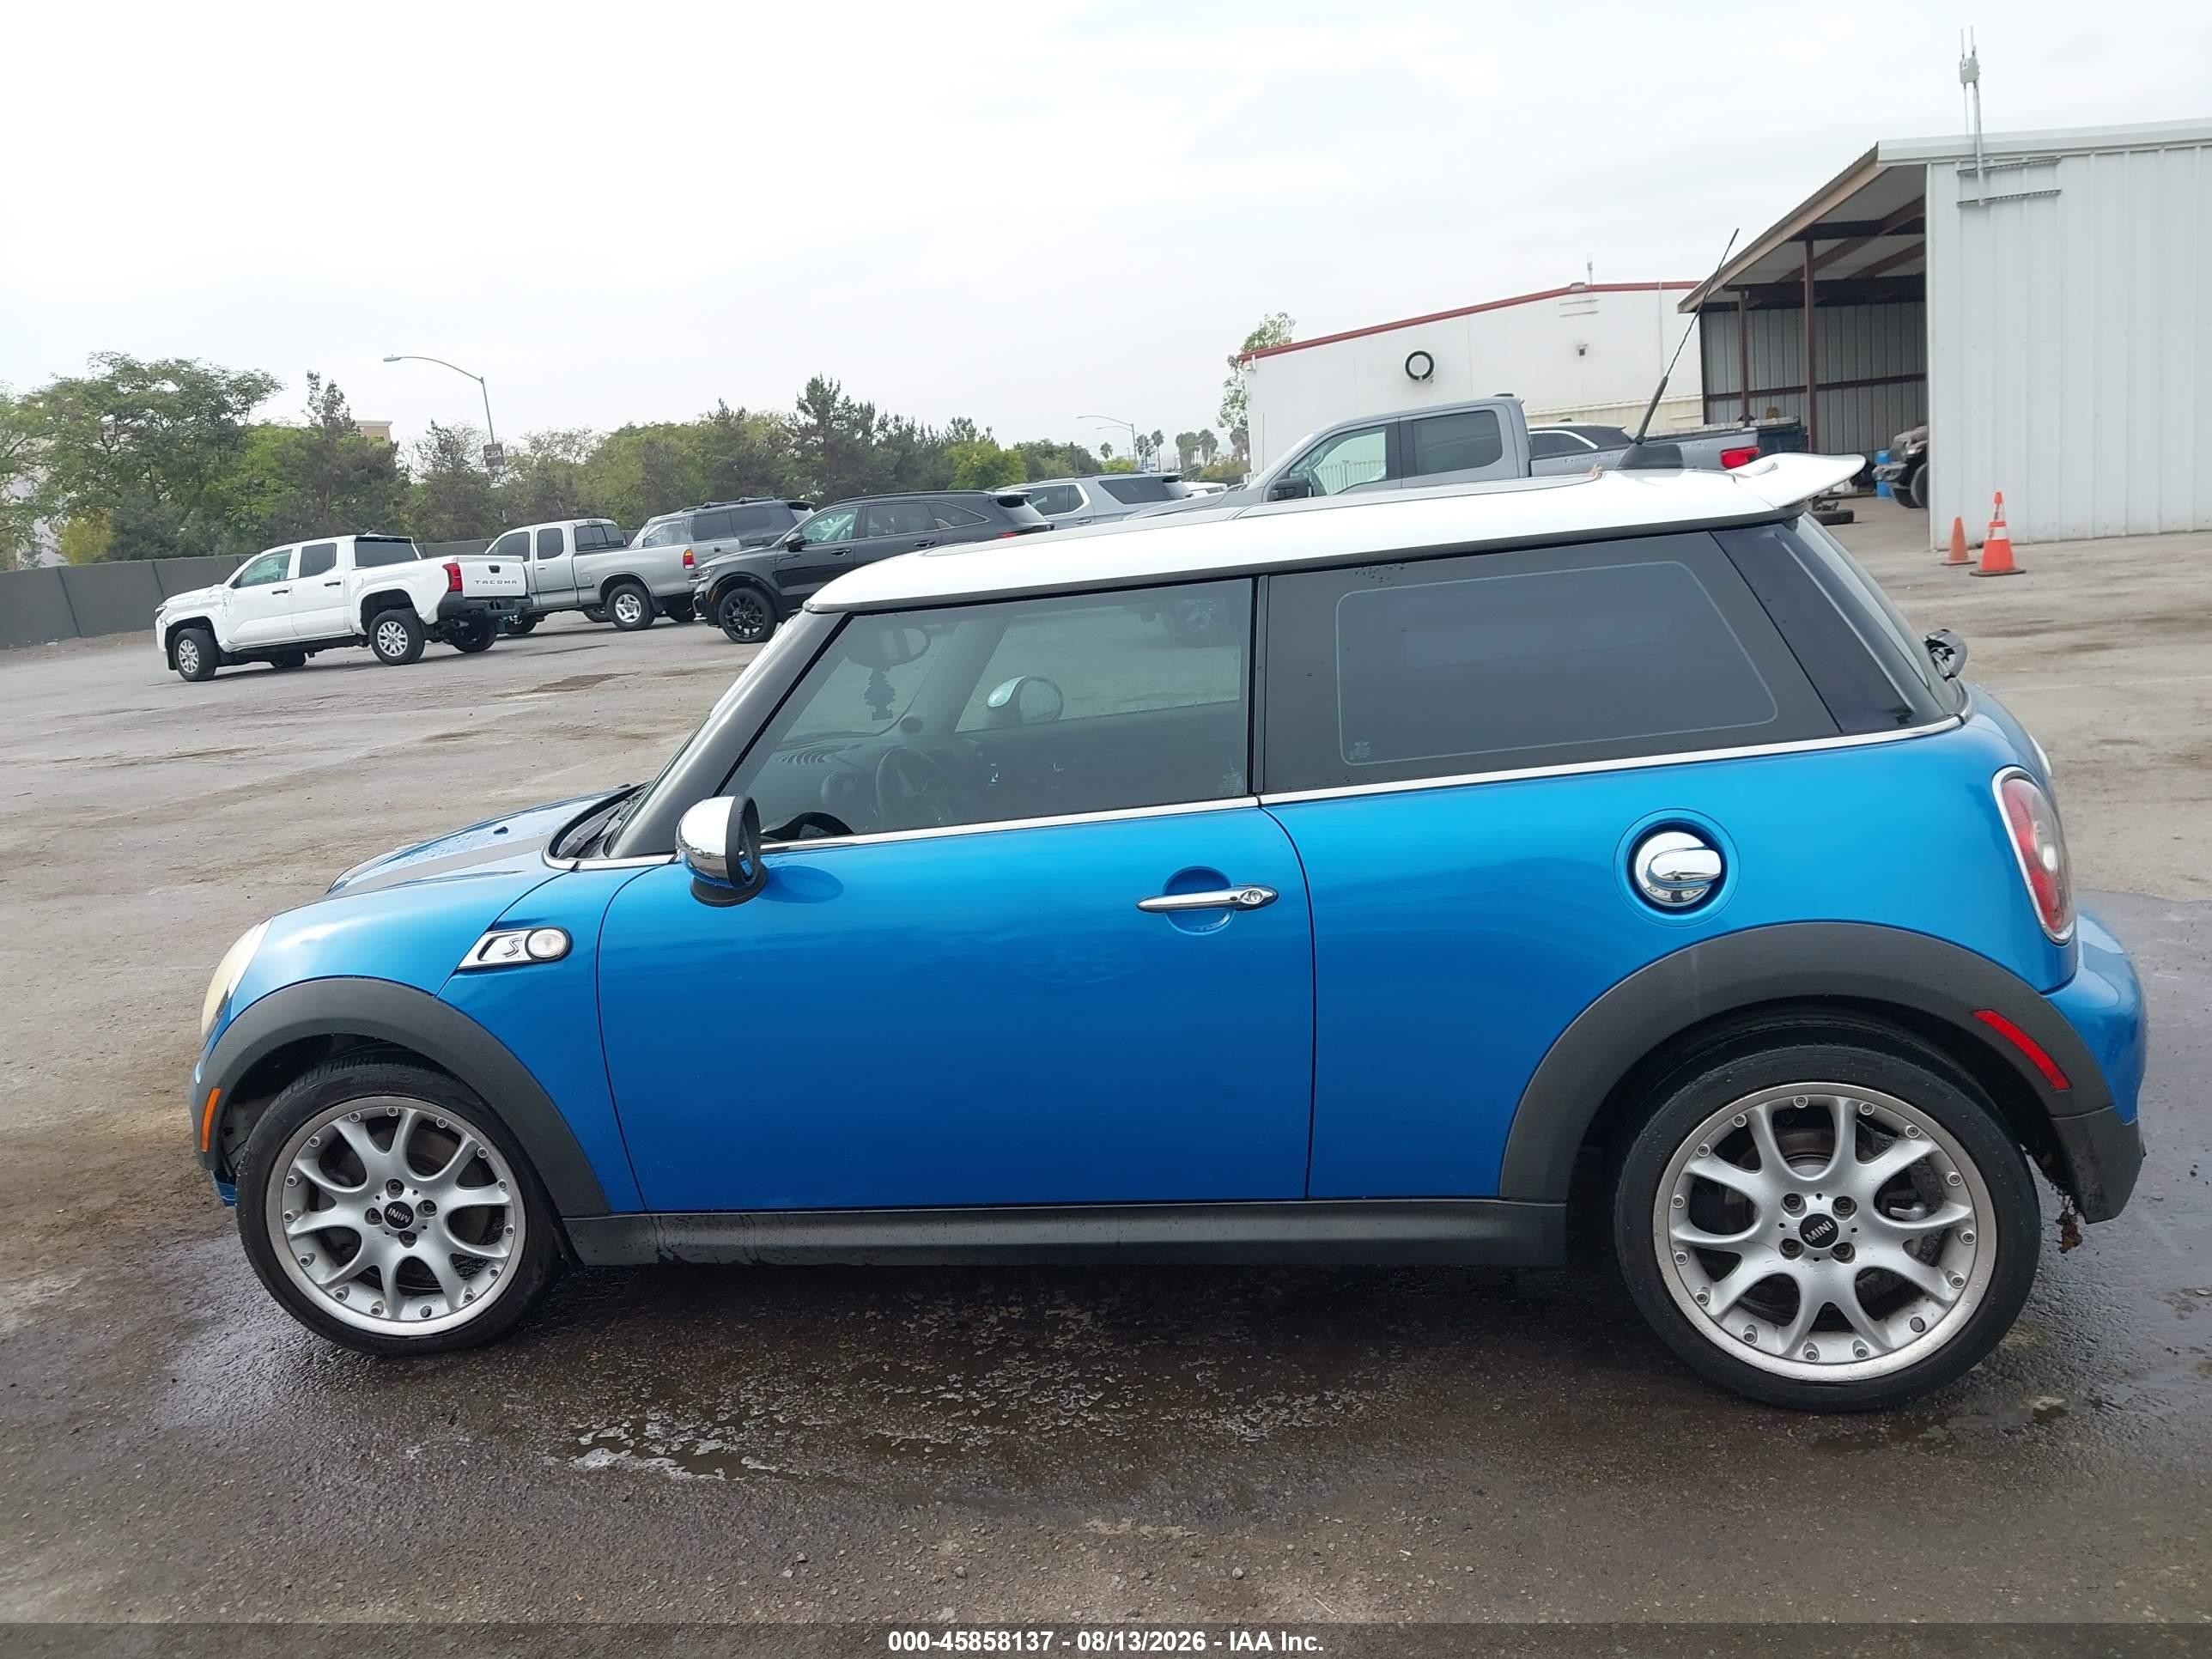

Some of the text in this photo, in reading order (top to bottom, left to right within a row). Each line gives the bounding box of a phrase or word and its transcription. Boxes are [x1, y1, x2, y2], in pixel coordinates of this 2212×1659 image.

[502, 937, 522, 957] S
[386, 1207, 411, 1224] MINI
[1804, 1219, 1834, 1243] MINI
